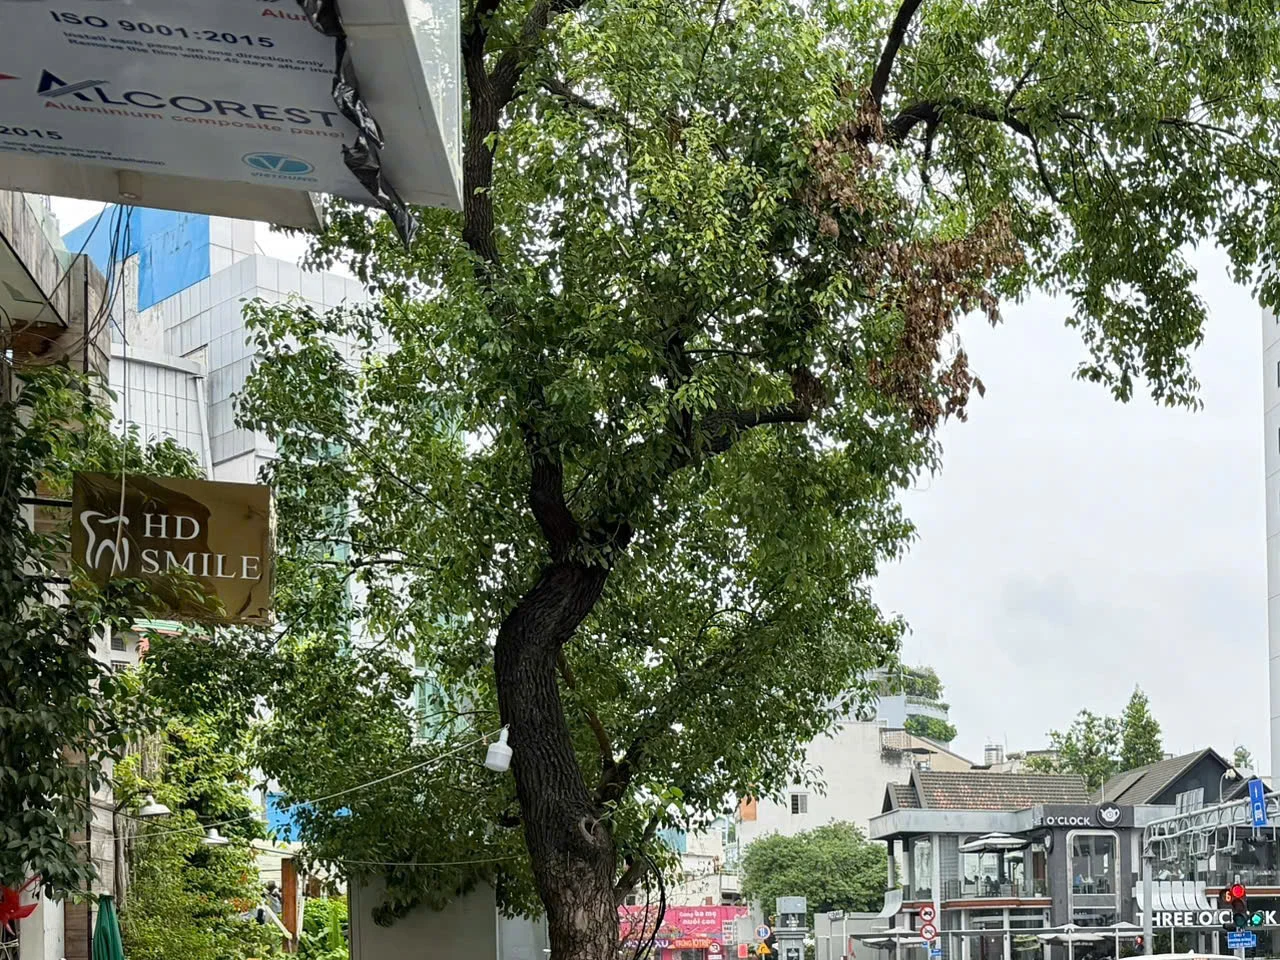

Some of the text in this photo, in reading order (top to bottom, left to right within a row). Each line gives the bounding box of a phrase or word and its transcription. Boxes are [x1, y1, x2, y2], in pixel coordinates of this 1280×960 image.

[50, 10, 275, 48] ISO 9001:2015
[37, 69, 338, 127] ALCOREST
[45, 101, 345, 139] Aluminium composite panel
[143, 513, 200, 540] HD
[141, 549, 263, 580] SMILE
[1046, 816, 1091, 826] O'CLOCK
